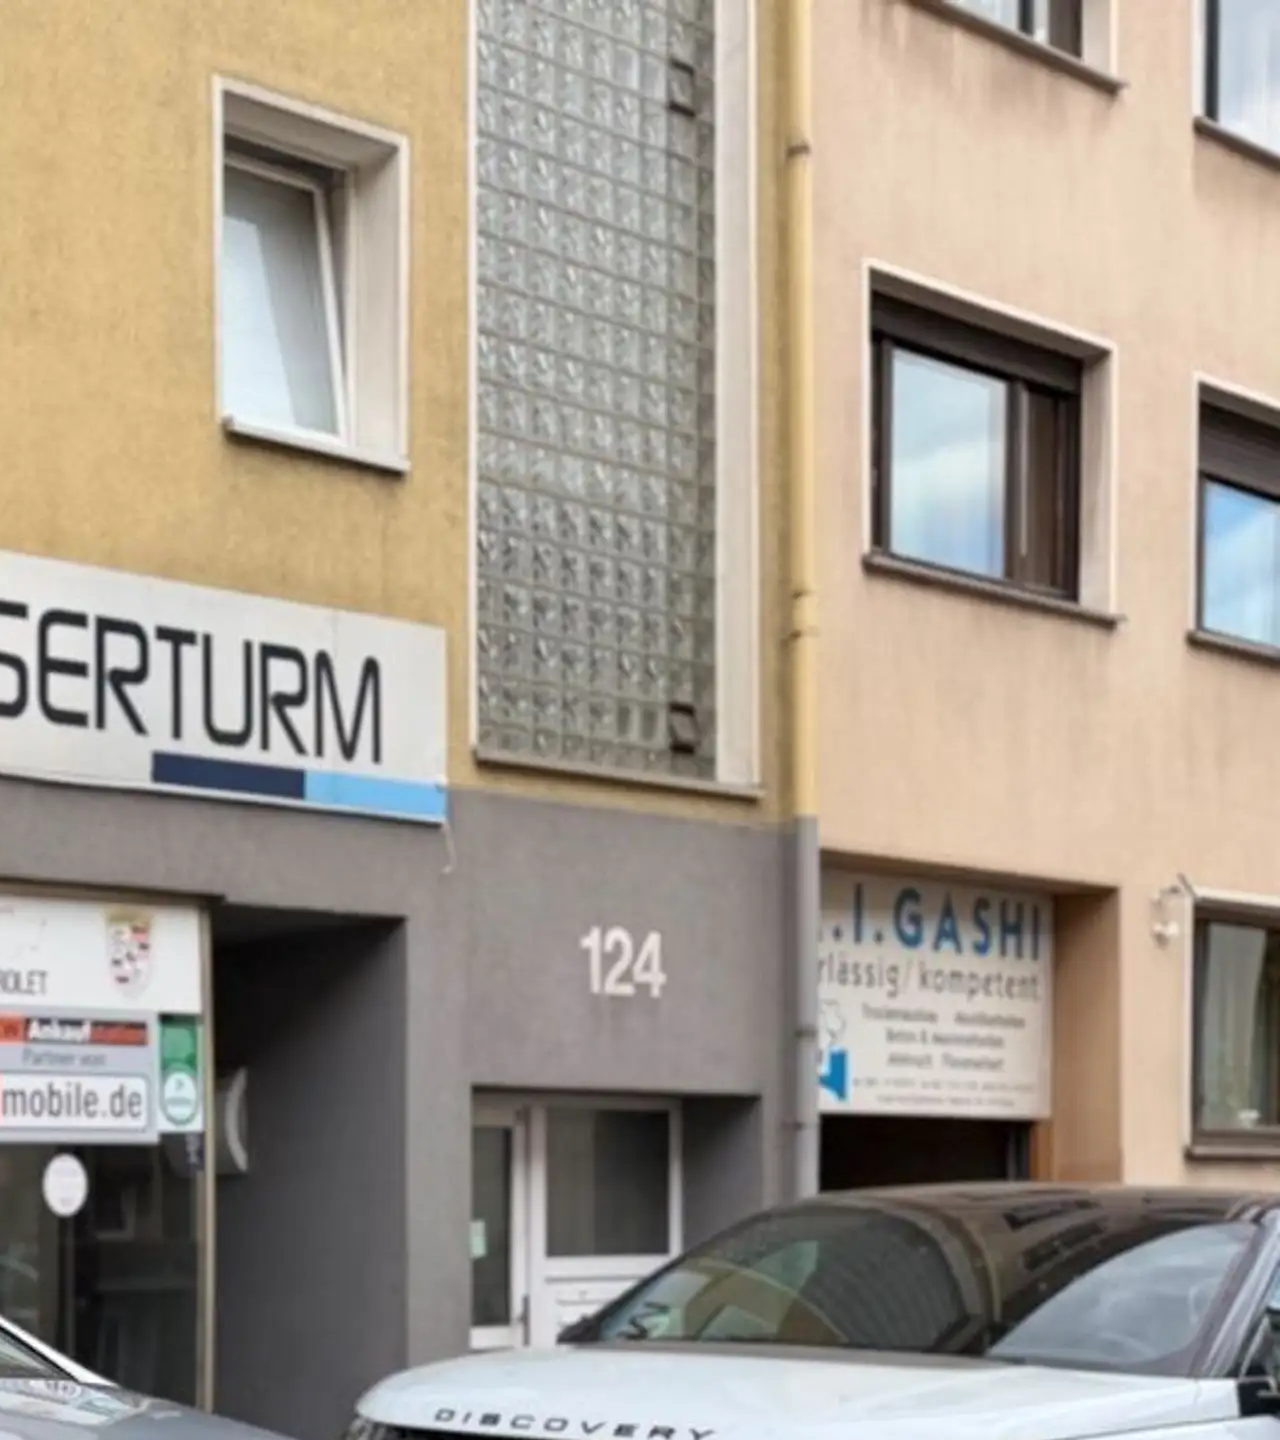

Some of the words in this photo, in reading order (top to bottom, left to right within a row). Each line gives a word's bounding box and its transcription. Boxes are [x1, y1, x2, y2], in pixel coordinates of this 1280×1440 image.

[819, 882, 1040, 961] .I.GASHI
[579, 925, 668, 999] 124
[1, 1081, 143, 1119] mobile.de
